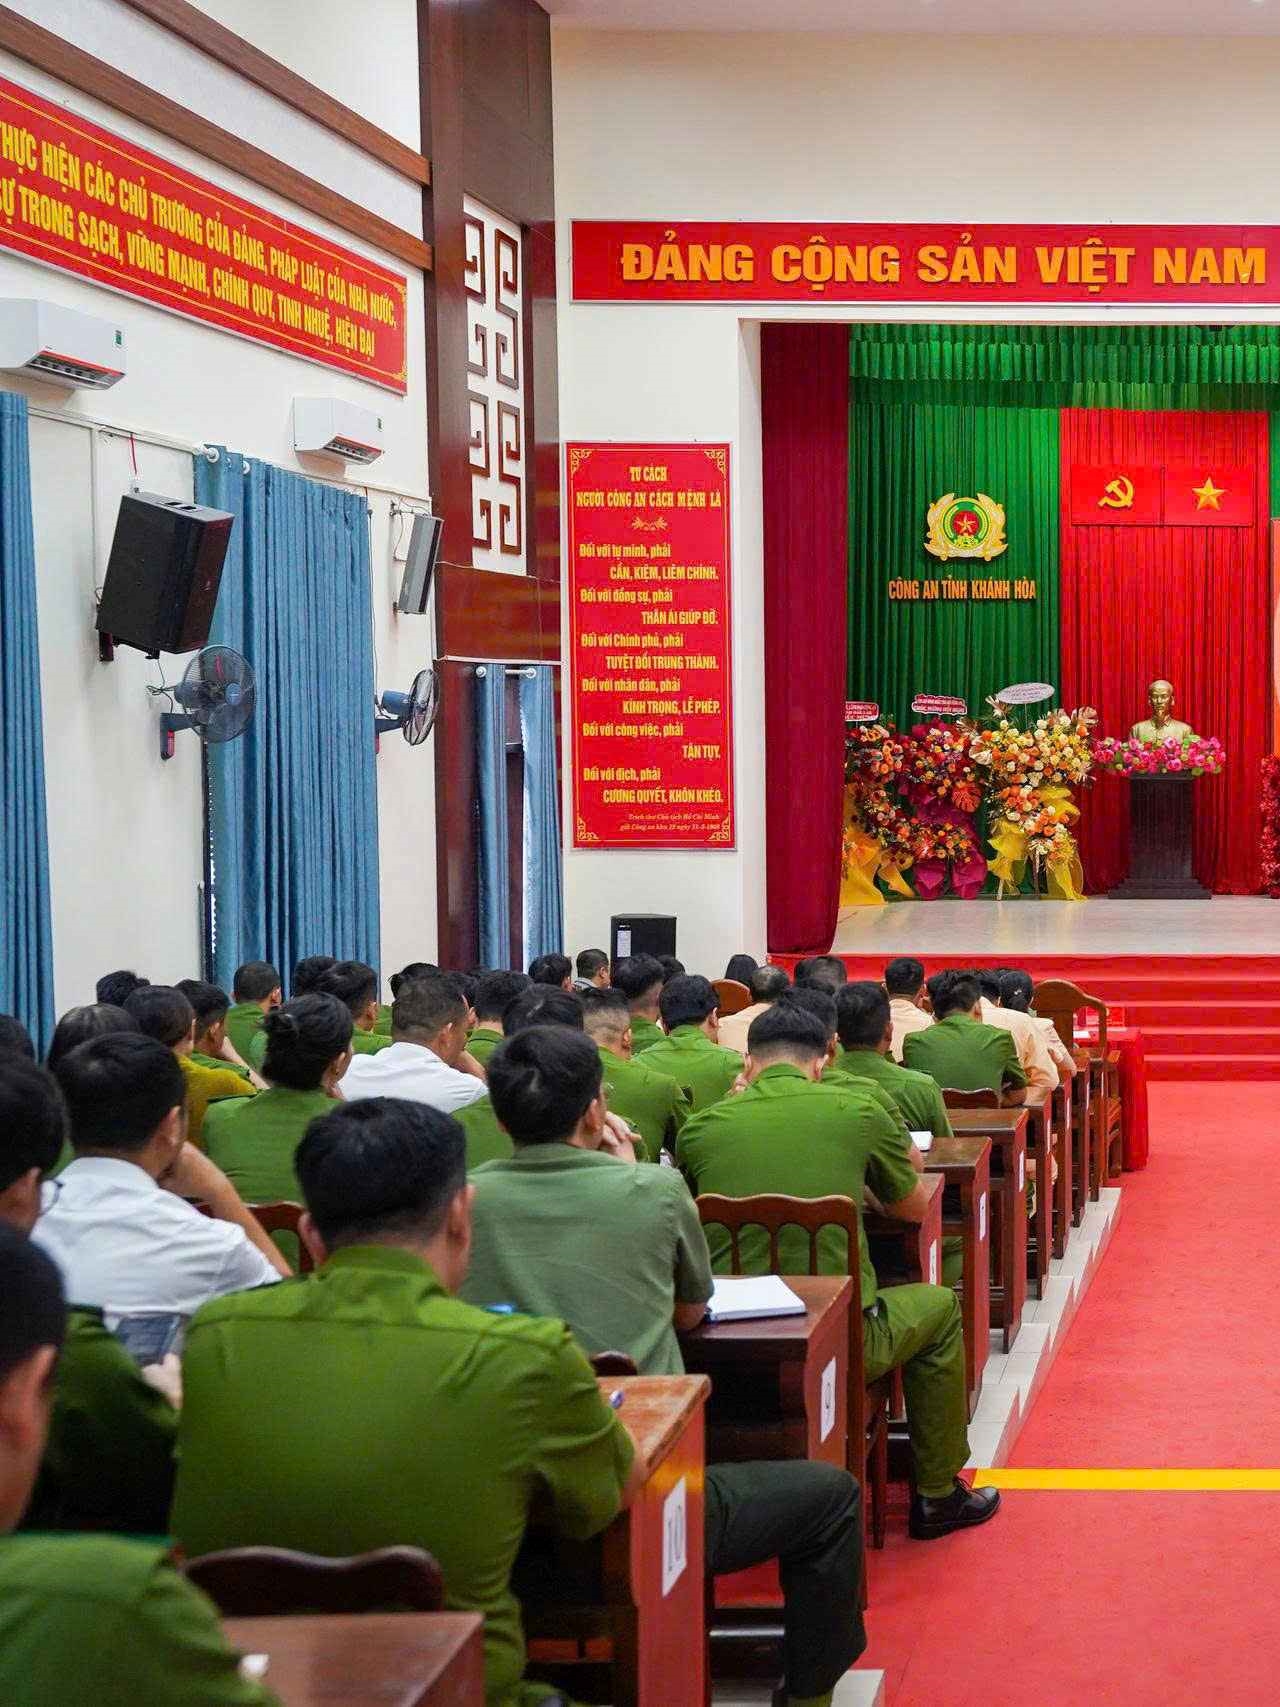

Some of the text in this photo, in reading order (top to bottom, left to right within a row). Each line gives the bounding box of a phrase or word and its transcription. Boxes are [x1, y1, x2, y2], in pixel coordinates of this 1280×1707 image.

[18, 184, 74, 241] TRONG
[78, 211, 124, 265] SẠCH,
[127, 229, 164, 276] VỮNG
[167, 247, 210, 298] MẠNH,
[213, 266, 249, 310] CHÍNH
[252, 283, 275, 322] QUY,
[277, 293, 301, 330] TINH
[304, 304, 333, 347] NHUỆ,
[336, 315, 357, 353] HIỆN
[360, 328, 375, 361] ĐẠI
[41, 140, 80, 193] HIỆN
[84, 160, 115, 206] CÁC
[119, 176, 147, 221] CHỦ
[150, 191, 203, 245] TRƯƠNG
[206, 211, 230, 256] CỦA
[233, 223, 268, 276] ĐẢNG,
[270, 247, 298, 285] PHÁP
[301, 261, 325, 300] LUẬT
[327, 266, 347, 306] CỦA
[348, 282, 368, 316] NHÀ
[370, 292, 397, 330] NƯỚC,
[622, 231, 752, 280] ĐẢNG
[772, 236, 899, 290] CỘNG
[919, 234, 1016, 282] SẢN
[1036, 239, 1134, 291] VIỆT
[1154, 248, 1265, 283] NAM
[888, 574, 1037, 600] CÔNG AN TỈNH KHÁNH HÒA
